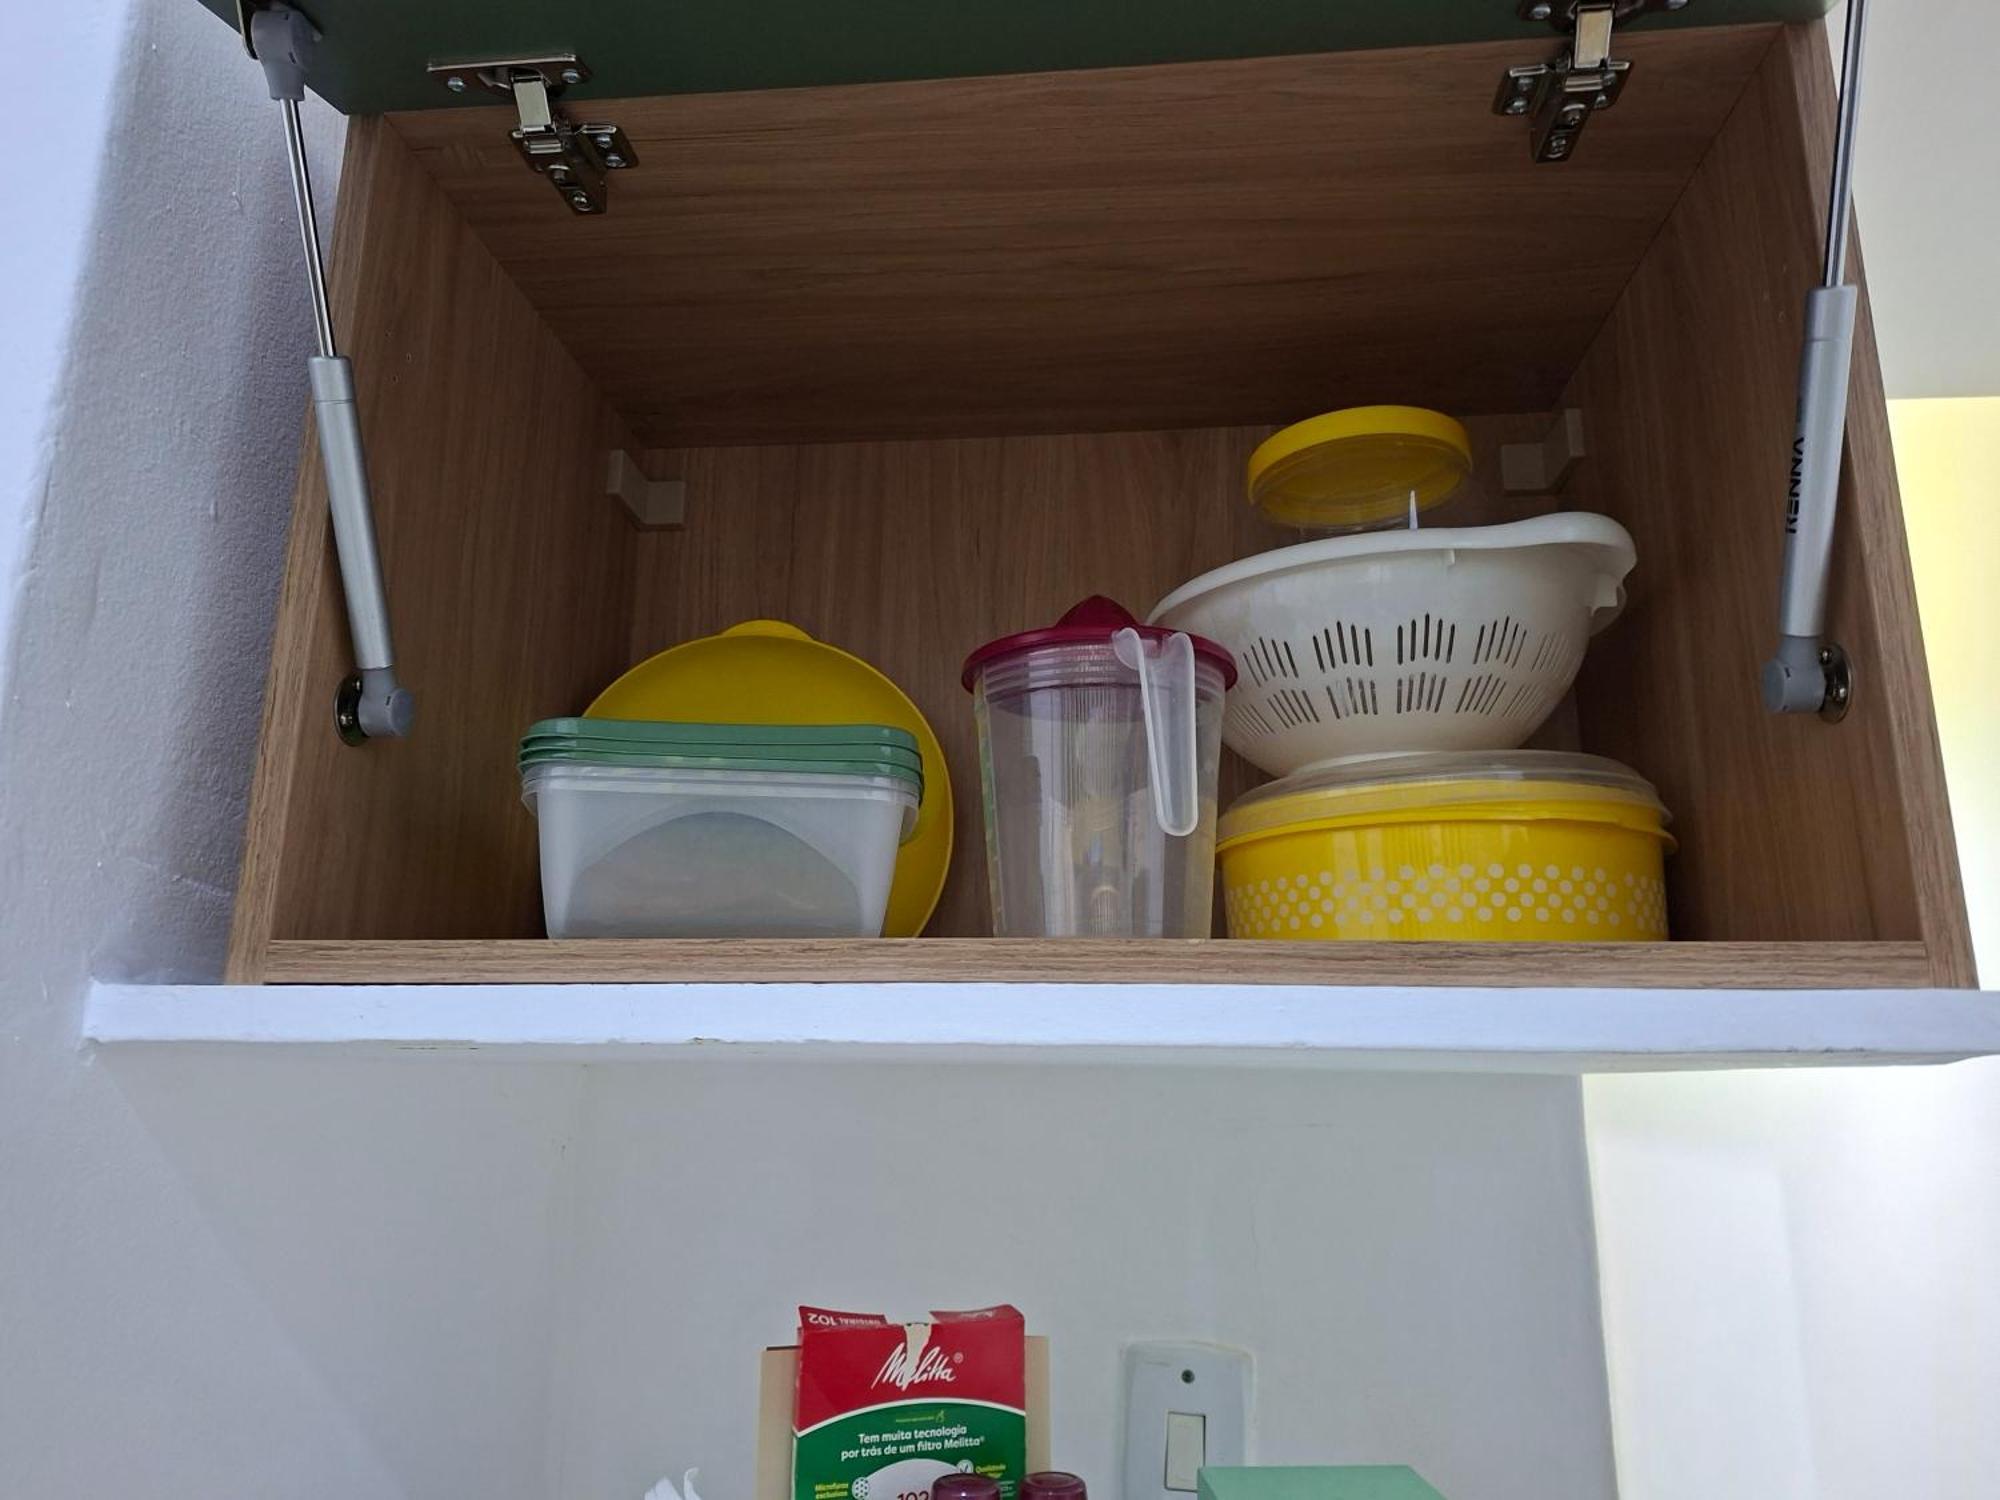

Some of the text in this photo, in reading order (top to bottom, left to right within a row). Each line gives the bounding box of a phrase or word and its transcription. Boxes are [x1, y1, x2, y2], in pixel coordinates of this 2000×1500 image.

[807, 1313, 836, 1326] 102
[858, 1424, 967, 1444] Tem muita tecnologia
[840, 1449, 859, 1462] por
[861, 1445, 882, 1457] trás
[884, 1444, 898, 1455] de
[899, 1444, 916, 1453] um
[917, 1440, 942, 1452] filtro
